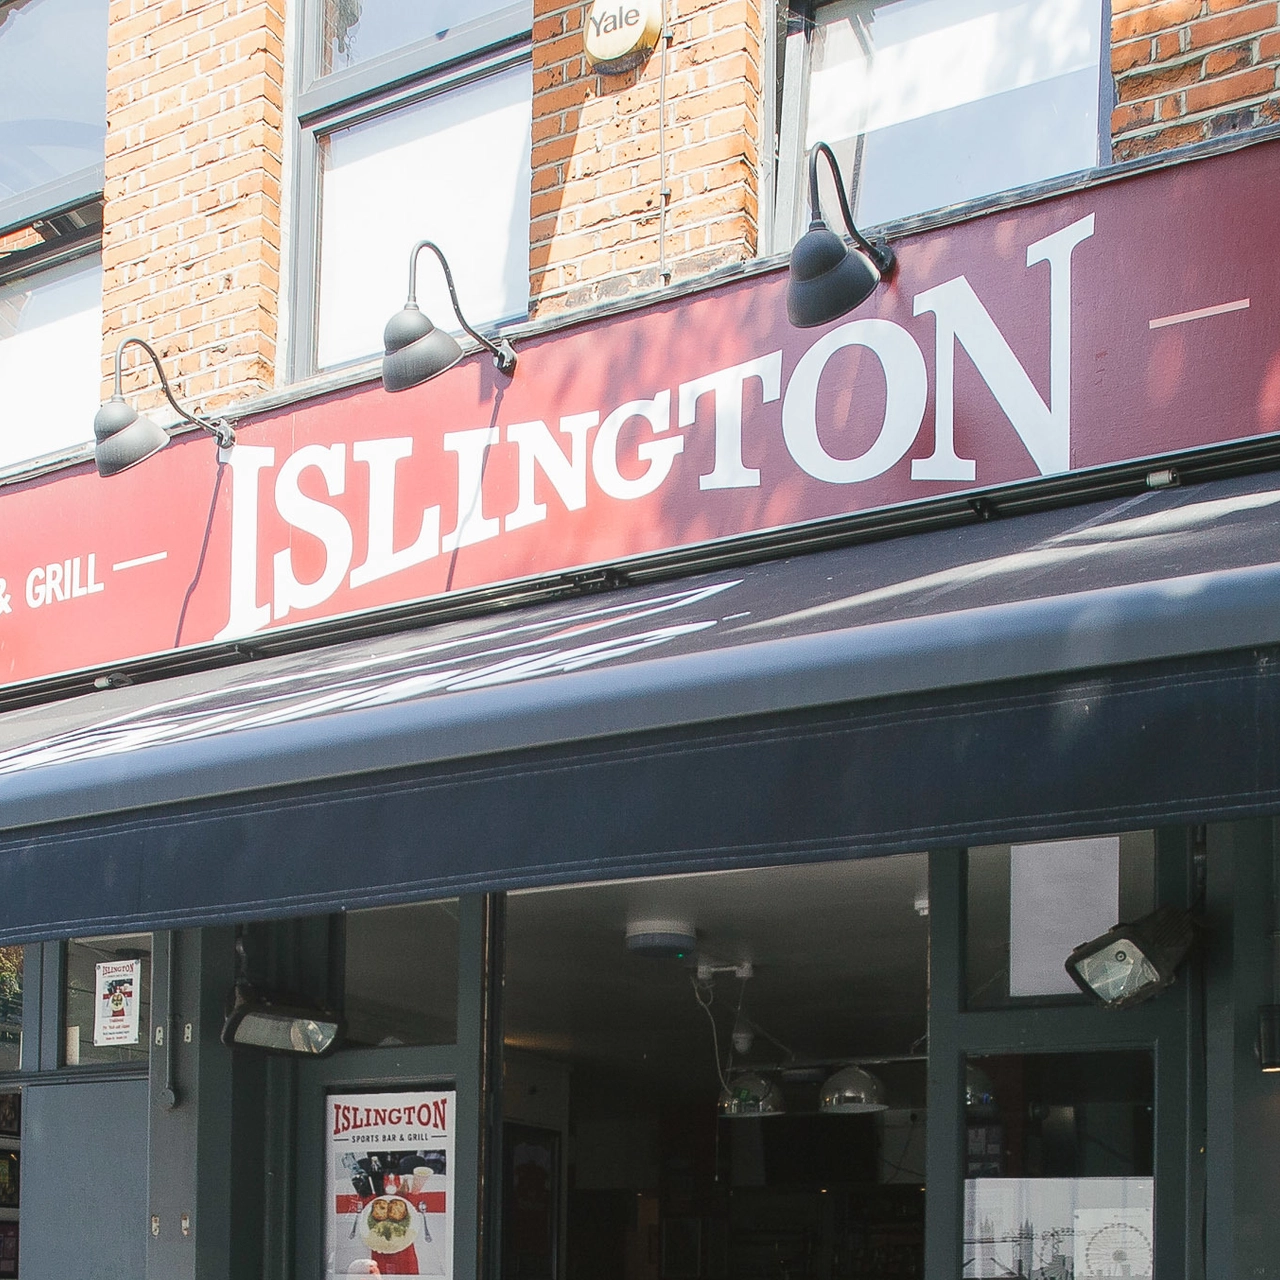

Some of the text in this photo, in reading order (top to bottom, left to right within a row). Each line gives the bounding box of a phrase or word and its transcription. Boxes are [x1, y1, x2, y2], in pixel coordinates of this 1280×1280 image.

[590, 6, 640, 37] Yale
[213, 212, 1095, 642] ISLINGTON
[25, 553, 105, 609] GRILL
[333, 1098, 447, 1135] ISLINGTON
[351, 1134, 379, 1143] SPORTS
[382, 1134, 396, 1142] BAR
[407, 1132, 429, 1141] GRILL
